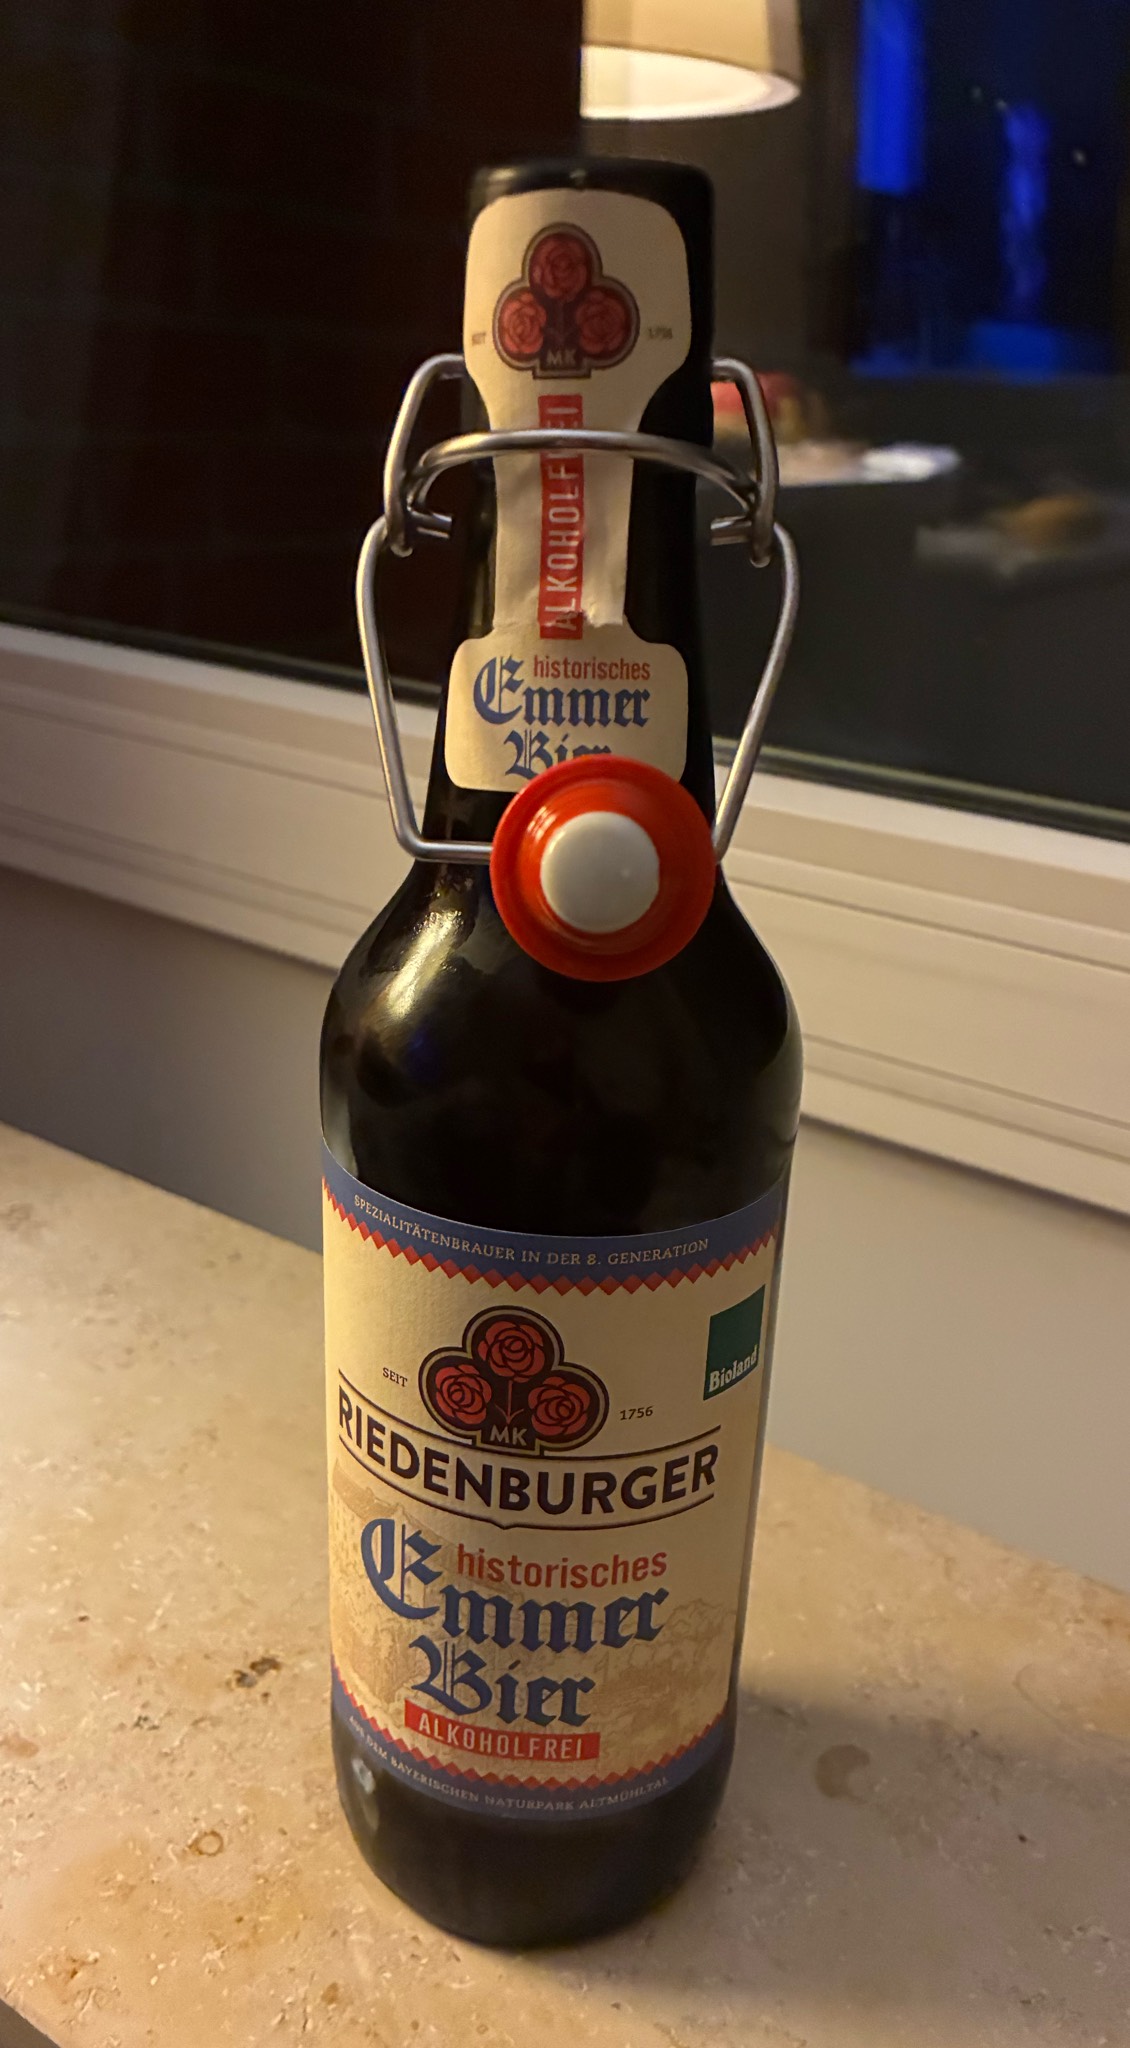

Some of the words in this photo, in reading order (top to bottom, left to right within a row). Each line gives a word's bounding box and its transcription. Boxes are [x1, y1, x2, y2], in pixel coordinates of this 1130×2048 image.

[546, 350, 577, 366] MK
[472, 655, 651, 728] Emmer
[533, 655, 651, 681] historisches
[503, 729, 612, 780] Bi
[354, 1193, 515, 1261] SPEZIALITÄTENBRAUER
[521, 1249, 541, 1263] IN
[546, 1252, 581, 1266] DER
[587, 1253, 602, 1266] 8.
[607, 1238, 710, 1266] GENERATION
[382, 1366, 408, 1388] SEIT
[708, 1343, 758, 1393] Bioland
[488, 1423, 529, 1447] MK
[619, 1405, 654, 1421] 1756
[338, 1384, 720, 1516] RIEDENBURGER
[360, 1518, 670, 1654] Emmer
[456, 1543, 668, 1589] historisches
[408, 1634, 597, 1728] Bier
[418, 1712, 582, 1760] ALKOHOLFREI
[390, 1755, 479, 1803] BAYERISCHEN
[484, 1794, 575, 1811] NATURPARK
